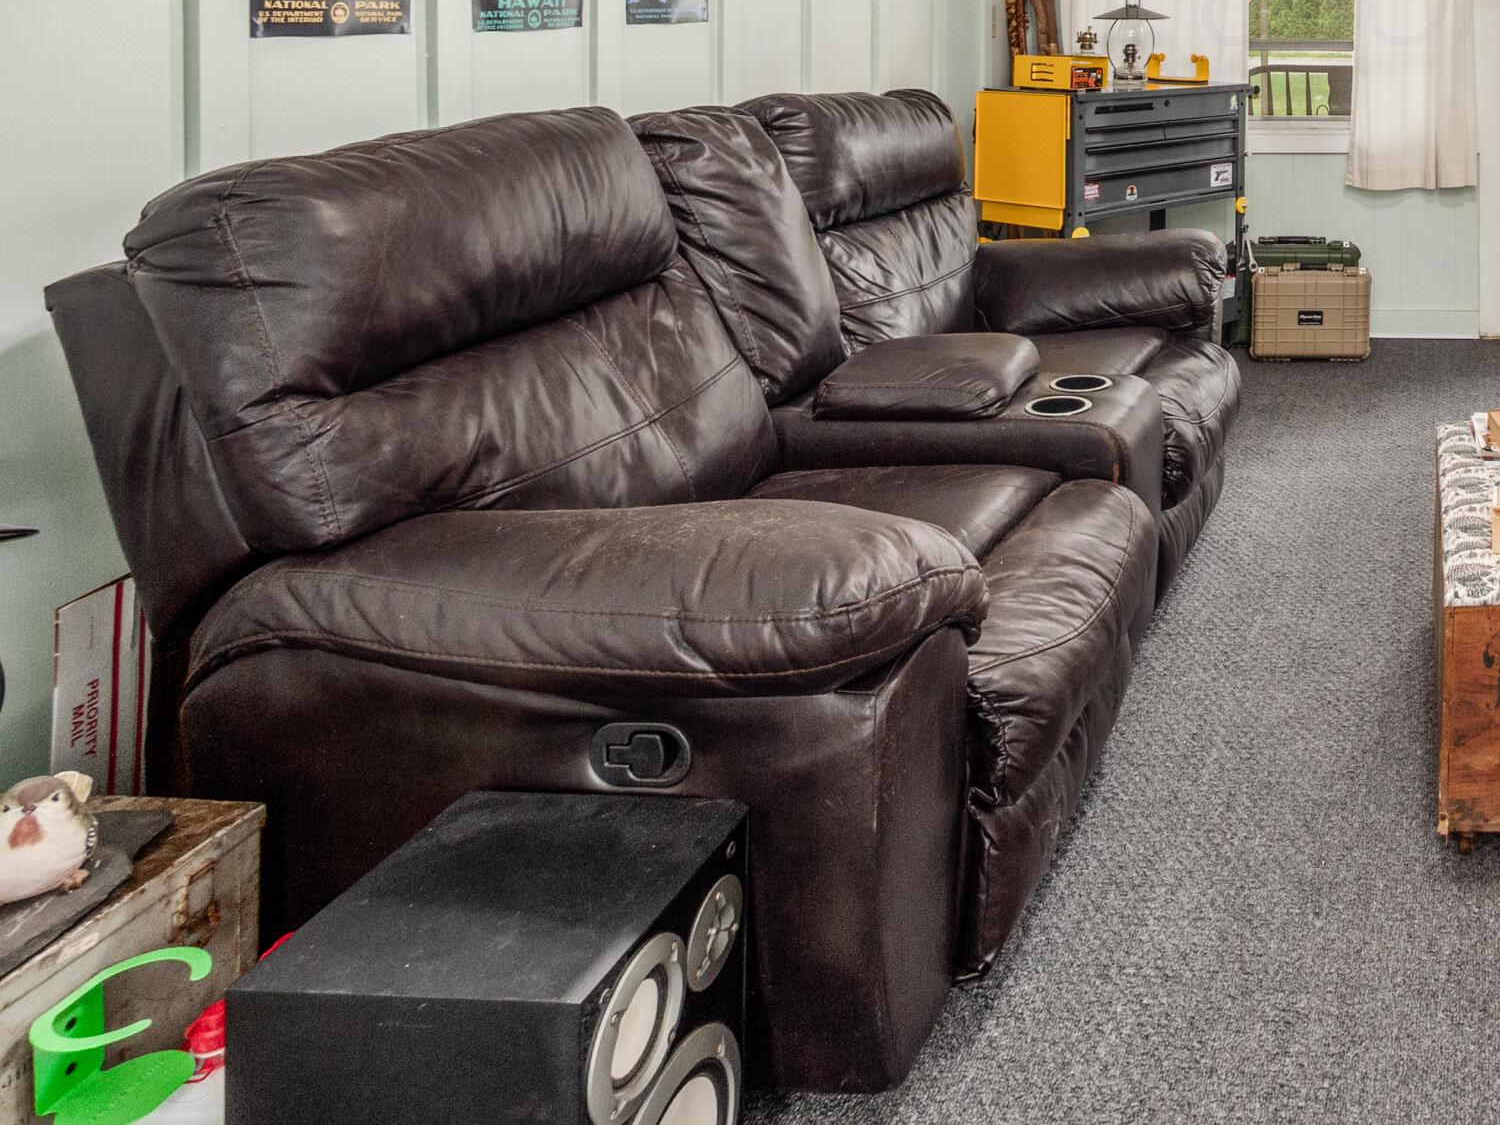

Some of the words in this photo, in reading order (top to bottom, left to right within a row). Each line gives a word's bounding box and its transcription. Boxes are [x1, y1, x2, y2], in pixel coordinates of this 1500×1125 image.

[264, 0, 329, 9] NATIONAL
[355, 1, 401, 10] PARK
[480, 10, 526, 18] NATIONAL
[543, 8, 579, 17] PARK
[70, 703, 85, 749] MAIL
[84, 677, 100, 758] PRIORITY
